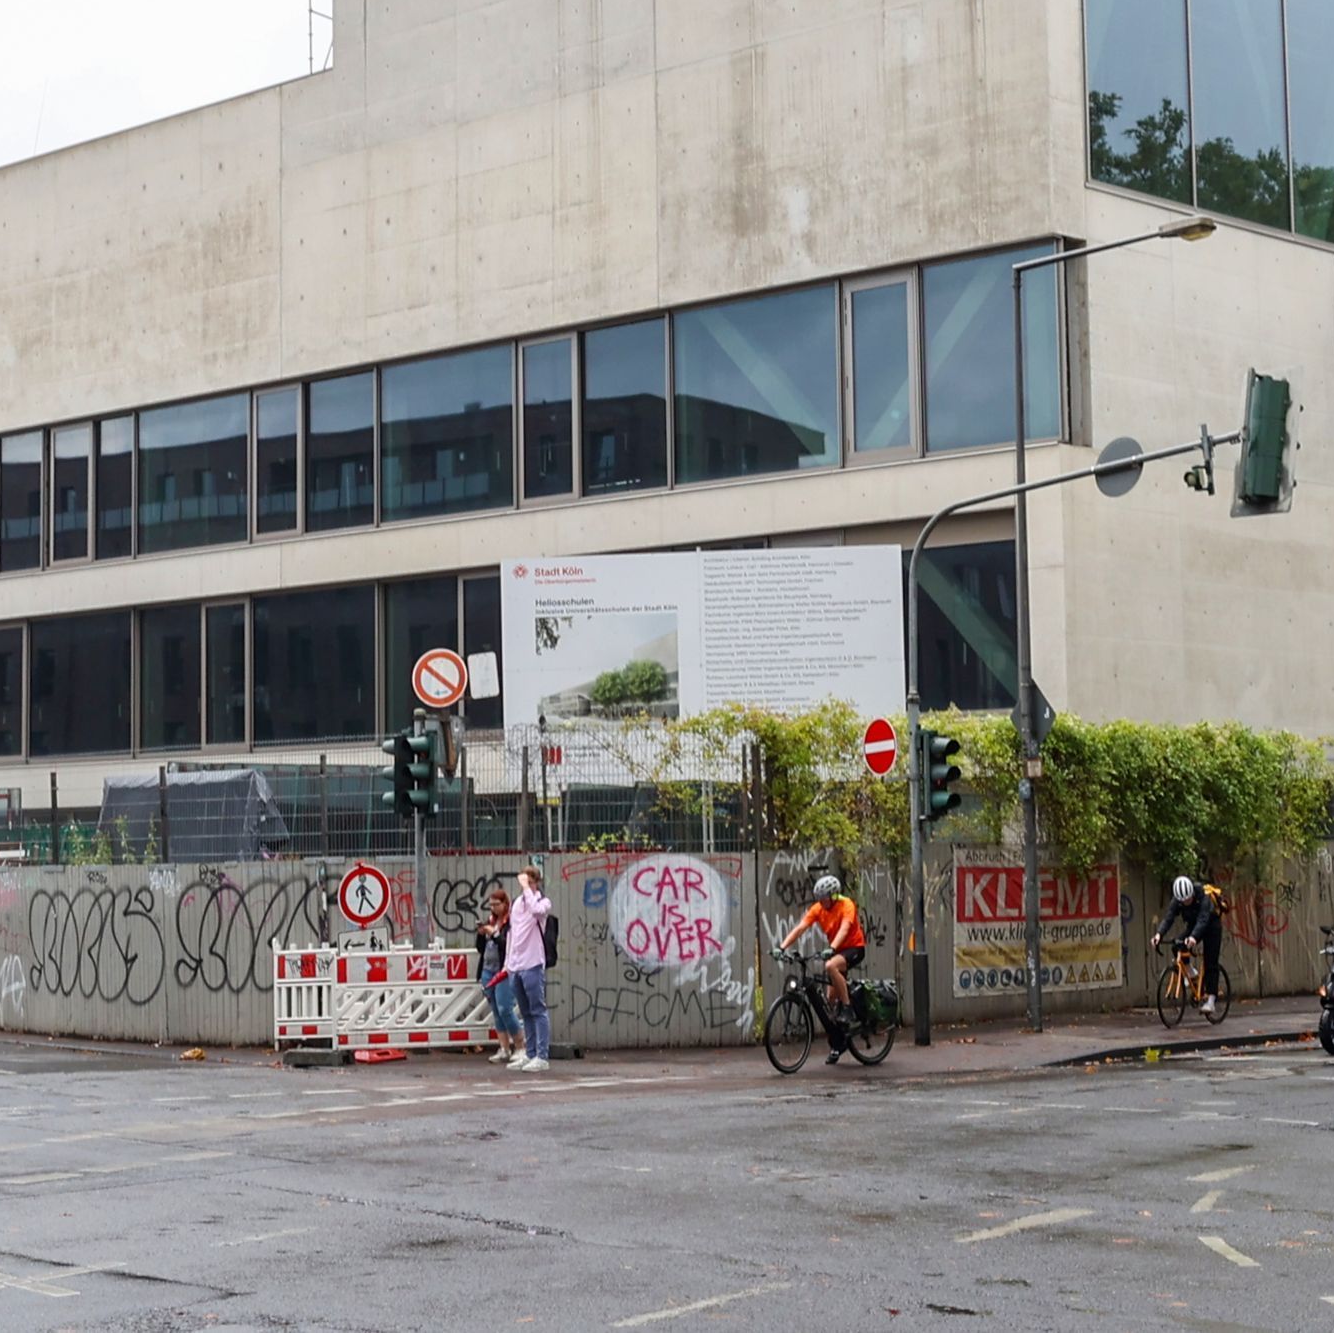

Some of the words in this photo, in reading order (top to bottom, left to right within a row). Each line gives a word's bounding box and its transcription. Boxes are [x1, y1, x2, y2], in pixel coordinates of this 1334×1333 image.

[534, 567, 560, 577] Stadt
[562, 566, 584, 576] Köln
[535, 597, 595, 608] Heliosschulen
[633, 866, 708, 904] CAR
[661, 903, 686, 927] IS
[626, 918, 724, 962] OVER
[967, 921, 1112, 944] www.klit-gruppe.de
